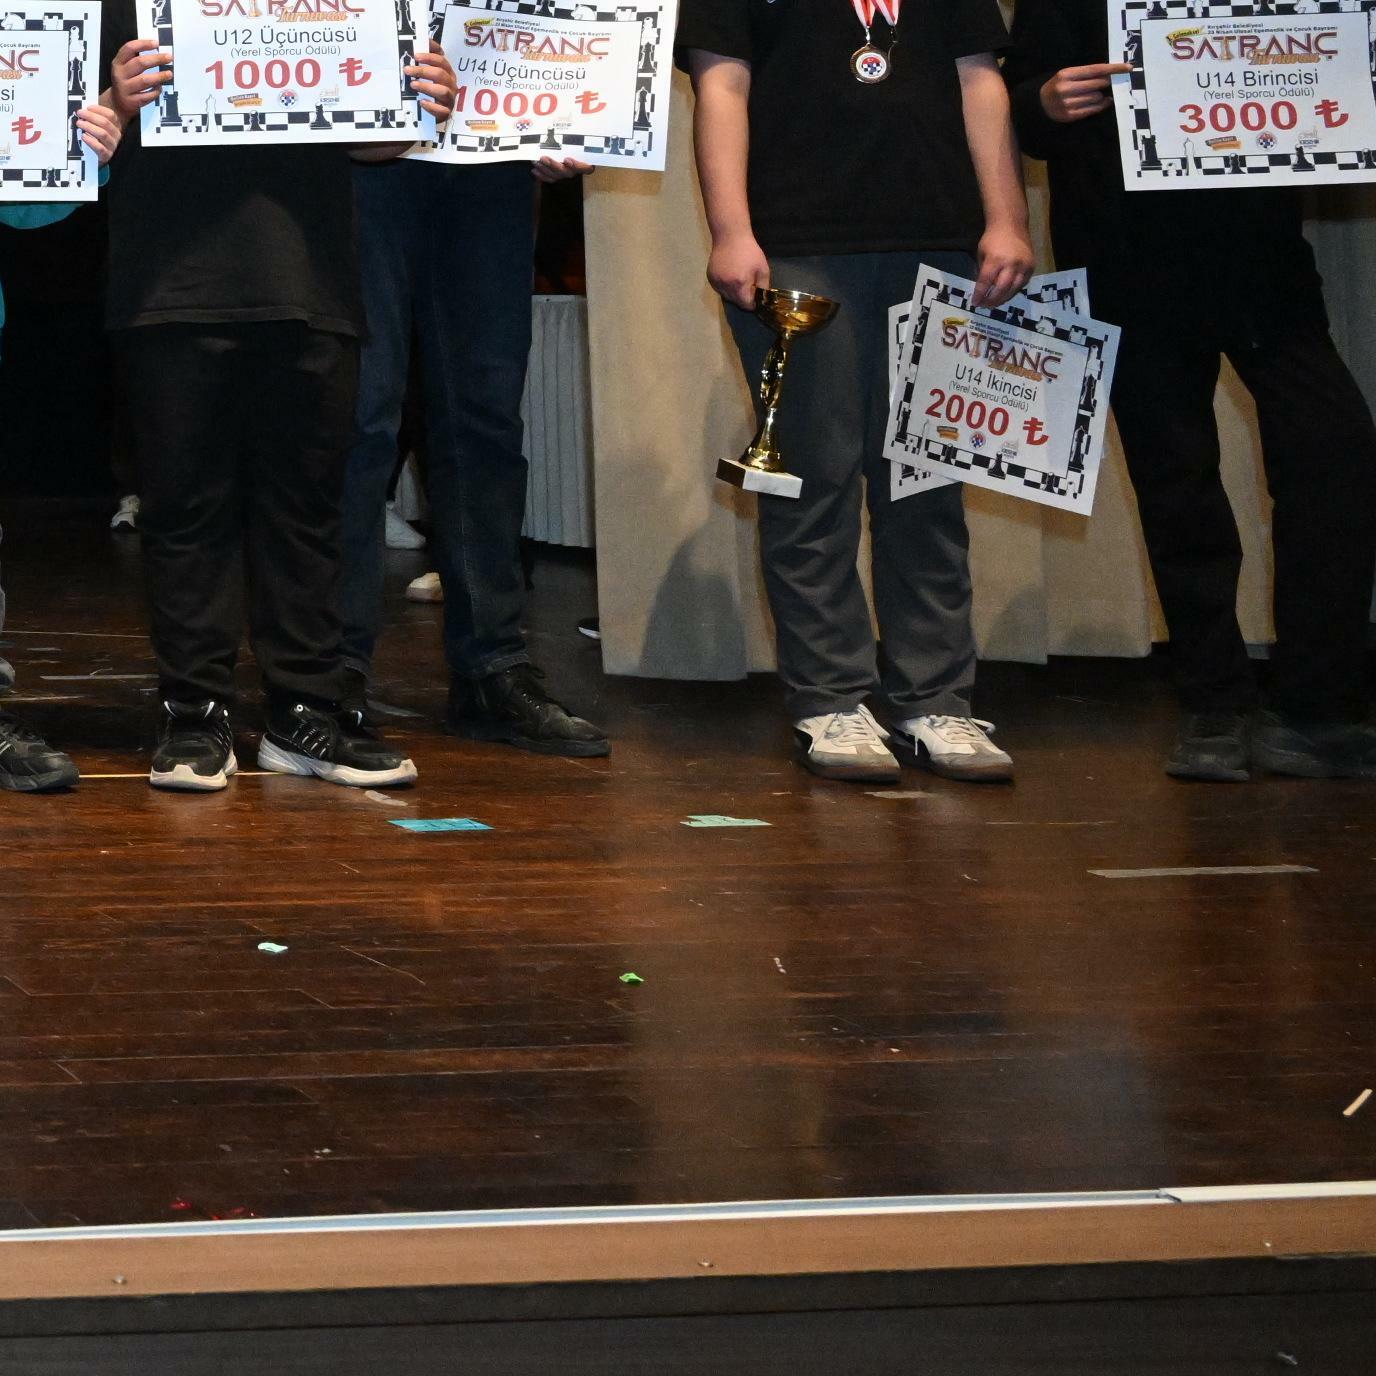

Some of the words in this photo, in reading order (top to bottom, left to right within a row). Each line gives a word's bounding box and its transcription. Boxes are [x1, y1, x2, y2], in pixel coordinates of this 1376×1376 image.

[213, 28, 253, 46] U12
[260, 25, 357, 49] Üçüncüsü
[230, 47, 261, 58] (Yerel
[264, 46, 302, 58] Sporcu
[464, 24, 610, 60] SATRANÇ
[1170, 31, 1339, 63] SATRANÇ
[205, 58, 321, 90] 1000
[457, 56, 487, 74] U14
[493, 57, 587, 82] Üçüncüsü
[504, 78, 541, 91] Sporcu
[1196, 71, 1236, 89] U14
[1243, 68, 1319, 87] Birincisi
[455, 85, 558, 118] 1000
[1203, 89, 1235, 101] (Yerel
[1237, 89, 1276, 100] Sporcu
[1178, 100, 1298, 134] 3000
[942, 322, 1062, 384] SATRANÇ
[955, 363, 983, 386] U14
[986, 370, 1038, 402] İkincisi
[972, 386, 1000, 403] Sporcu
[924, 388, 1010, 436] 2000
